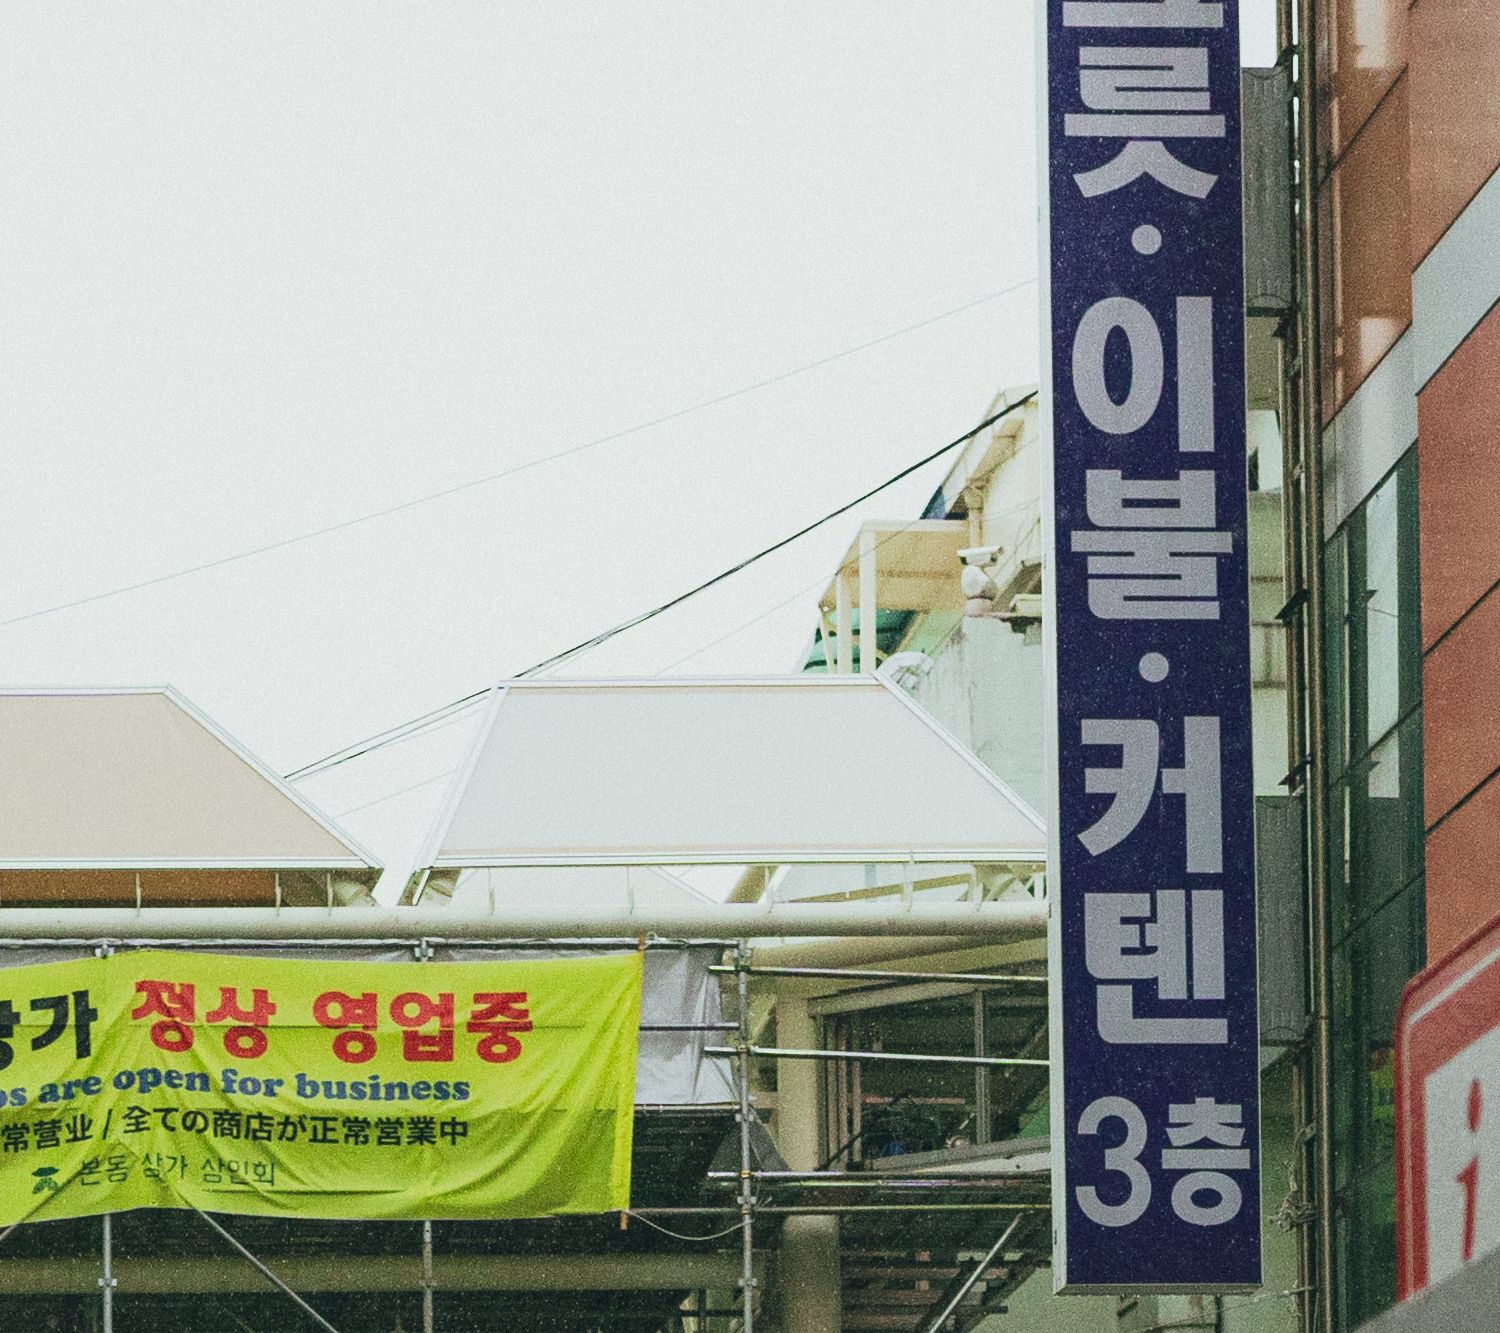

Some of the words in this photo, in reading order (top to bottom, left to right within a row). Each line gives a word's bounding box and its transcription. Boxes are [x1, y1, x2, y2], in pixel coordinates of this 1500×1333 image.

[131, 980, 277, 1060] 정상
[312, 990, 534, 1064] 영업중
[37, 1073, 103, 1105] are
[113, 1066, 211, 1094] open
[220, 1068, 285, 1098] for
[296, 1073, 471, 1102] business
[121, 1105, 469, 1147] 全ての商店が正常営業中
[201, 1157, 276, 1187] 상인회
[1075, 1096, 1252, 1228] 3층
